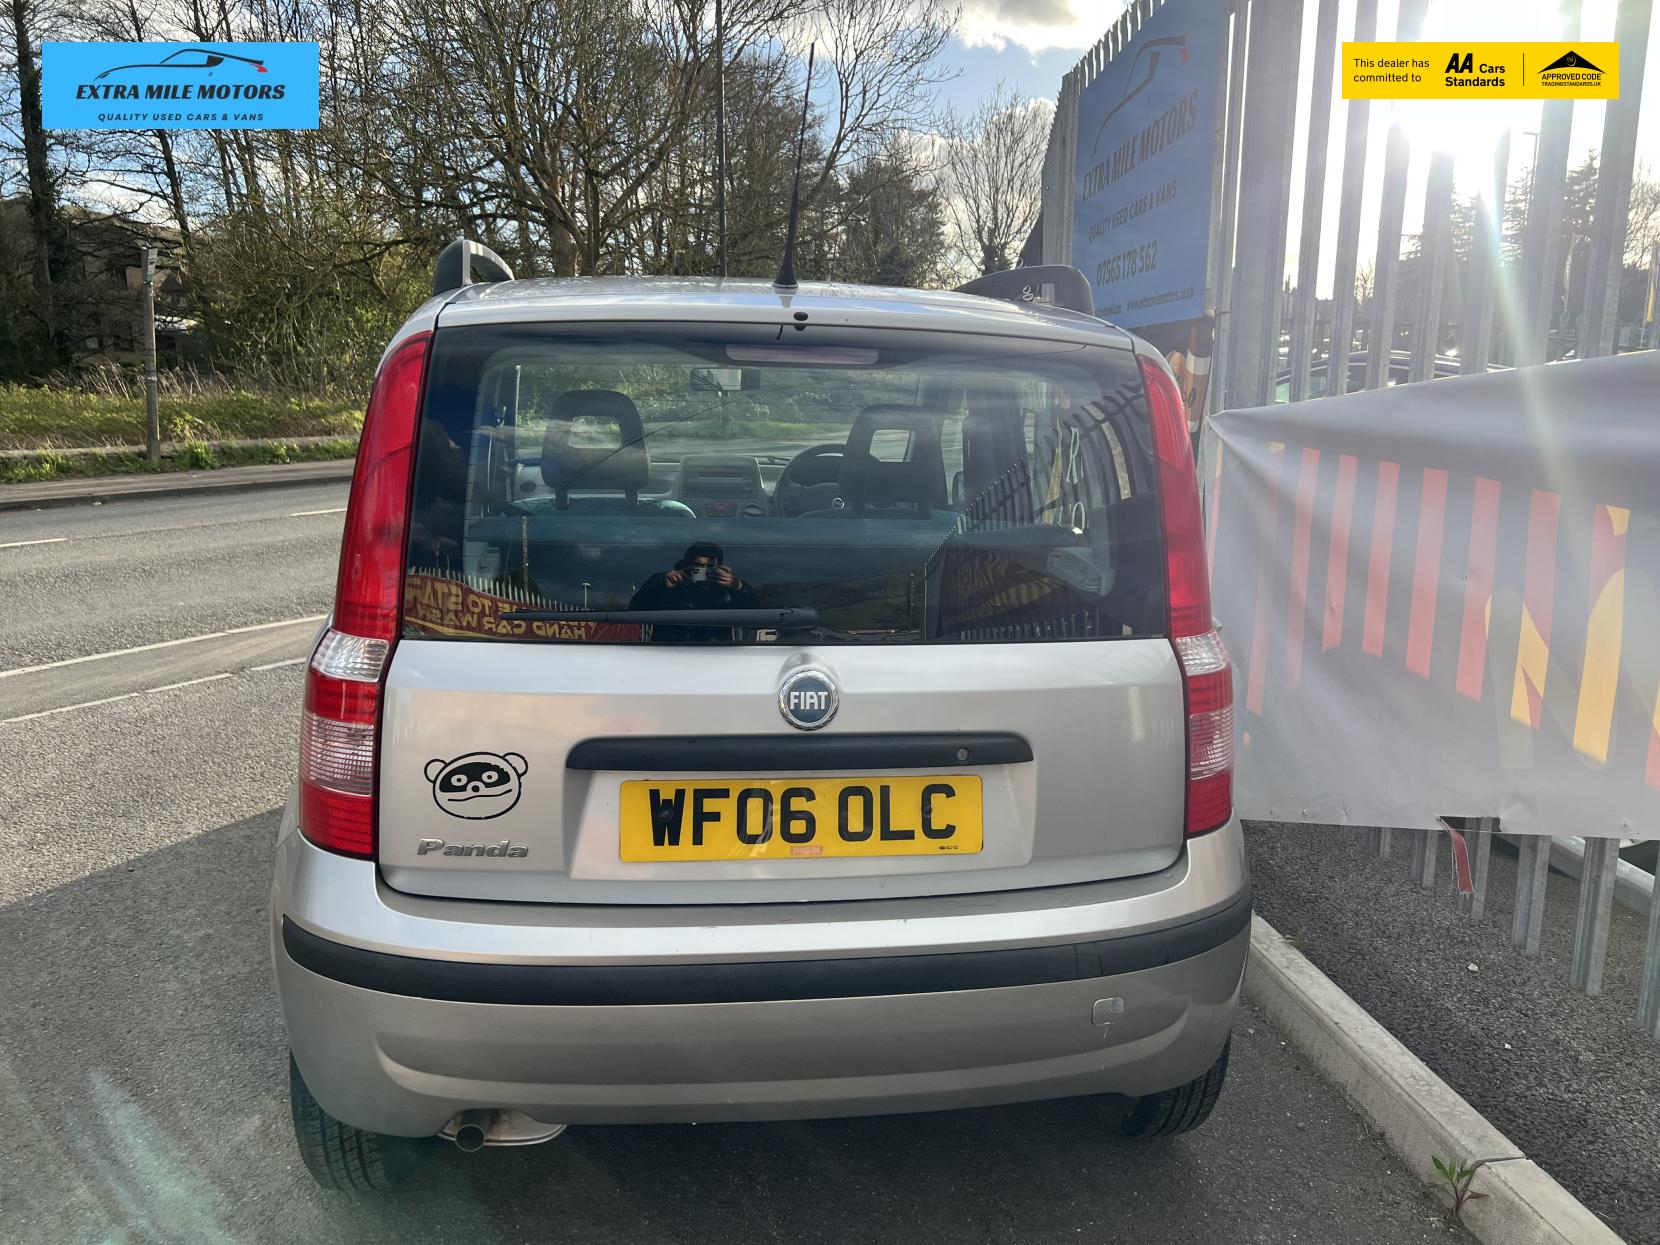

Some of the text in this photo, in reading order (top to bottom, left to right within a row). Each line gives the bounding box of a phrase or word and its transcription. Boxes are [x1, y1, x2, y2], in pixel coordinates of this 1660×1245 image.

[1082, 89, 1199, 202] EXTRA MILE MOTORS
[1088, 214, 1112, 244] QUALITY
[1111, 206, 1129, 229] USED
[1129, 195, 1148, 221] CARS
[1155, 179, 1177, 207] VANS
[1096, 239, 1158, 288] 07565 178 562
[789, 691, 828, 710] FIAT
[649, 783, 957, 847] WF06 OLC
[417, 838, 529, 858] Panda
